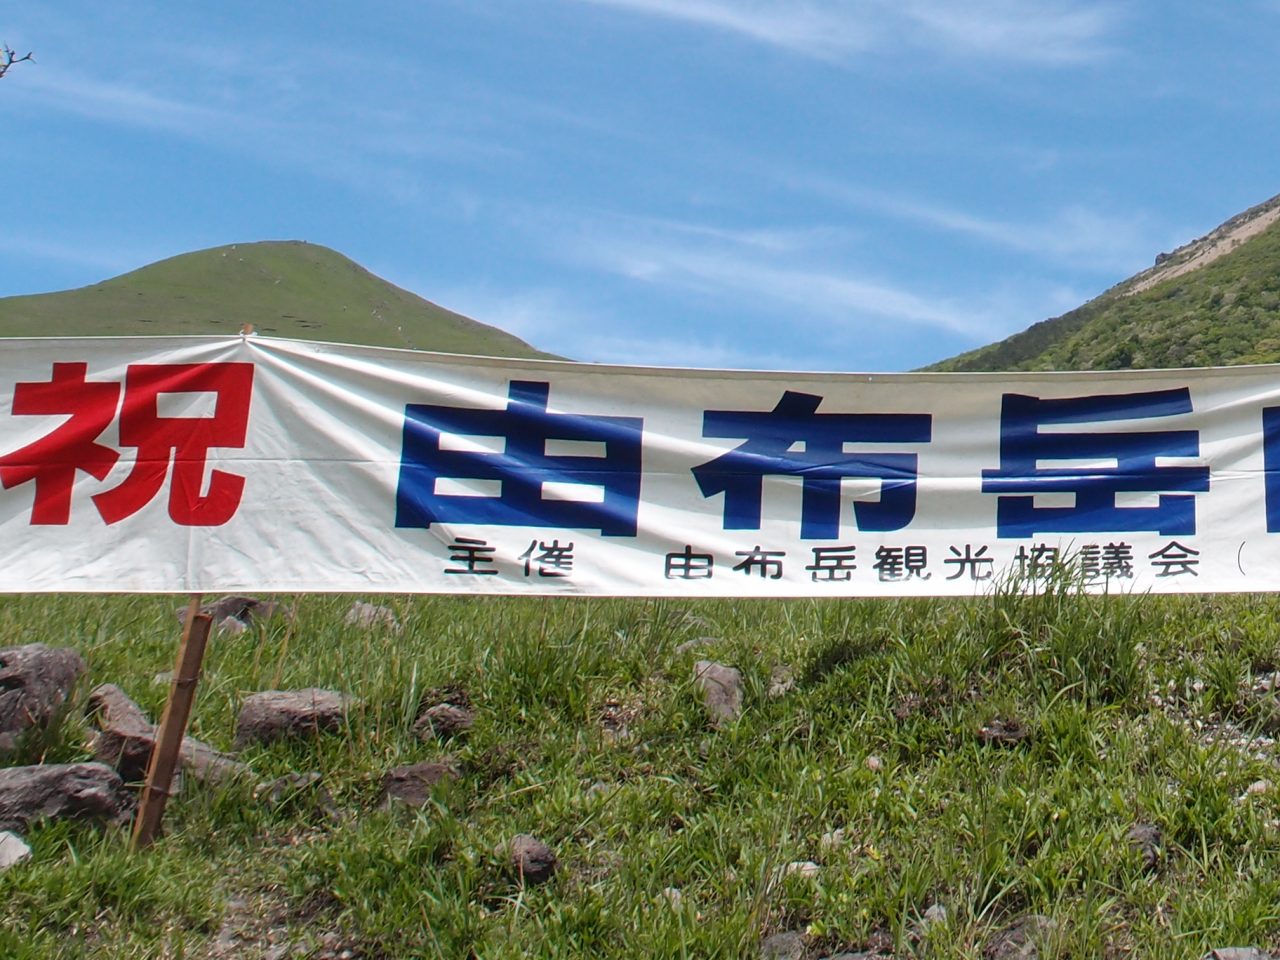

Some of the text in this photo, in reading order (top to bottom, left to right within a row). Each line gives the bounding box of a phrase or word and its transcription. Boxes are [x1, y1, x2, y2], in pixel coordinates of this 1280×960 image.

[0, 362, 254, 526] 祝
[443, 537, 574, 577] 主催
[664, 541, 1200, 581] 由布岳観光協議会
